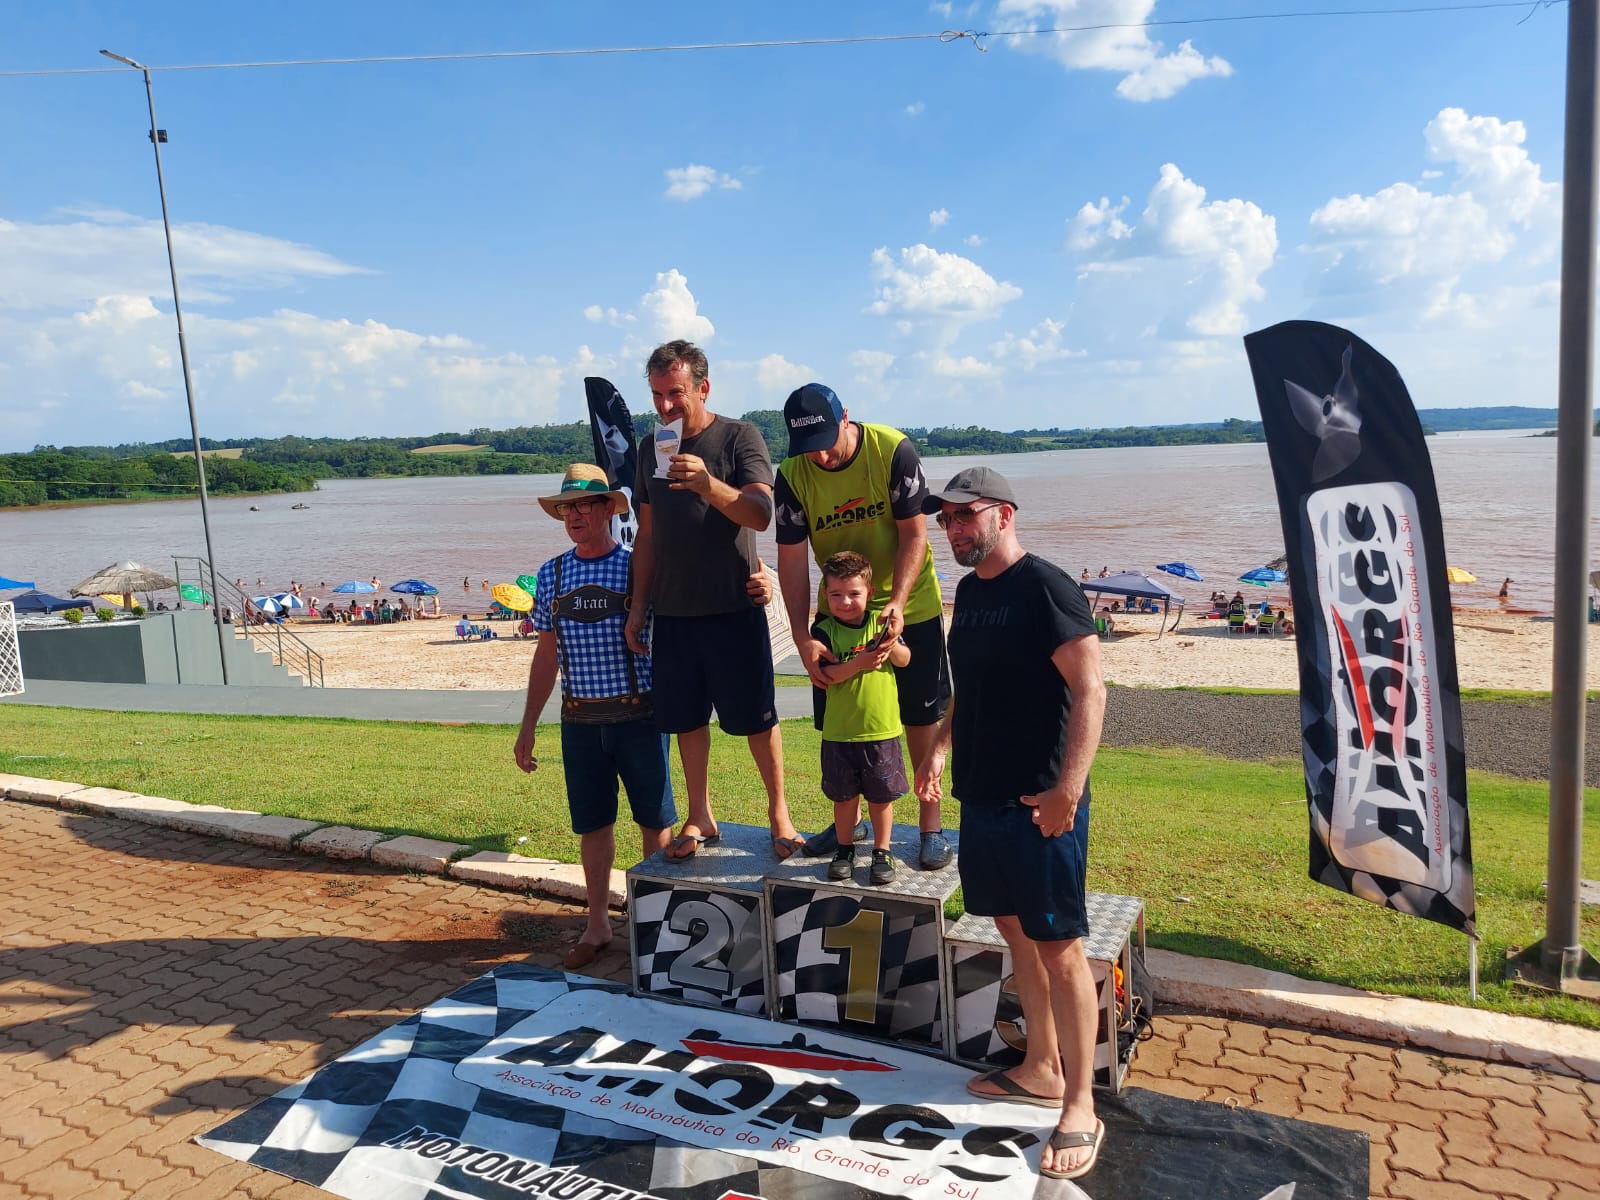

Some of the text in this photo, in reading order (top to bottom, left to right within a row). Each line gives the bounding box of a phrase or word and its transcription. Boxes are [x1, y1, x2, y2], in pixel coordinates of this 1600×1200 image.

[816, 501, 886, 531] AMORGS
[1345, 502, 1429, 869] AMORGS
[1400, 515, 1443, 856] Associação de Motonáutica do Rio Grande do Sul
[668, 900, 735, 995] 2
[824, 909, 885, 1024] 1
[496, 1026, 1041, 1182] AMORGS
[496, 1069, 979, 1200] Associação de Motonáutica do Rio Grande do Sul
